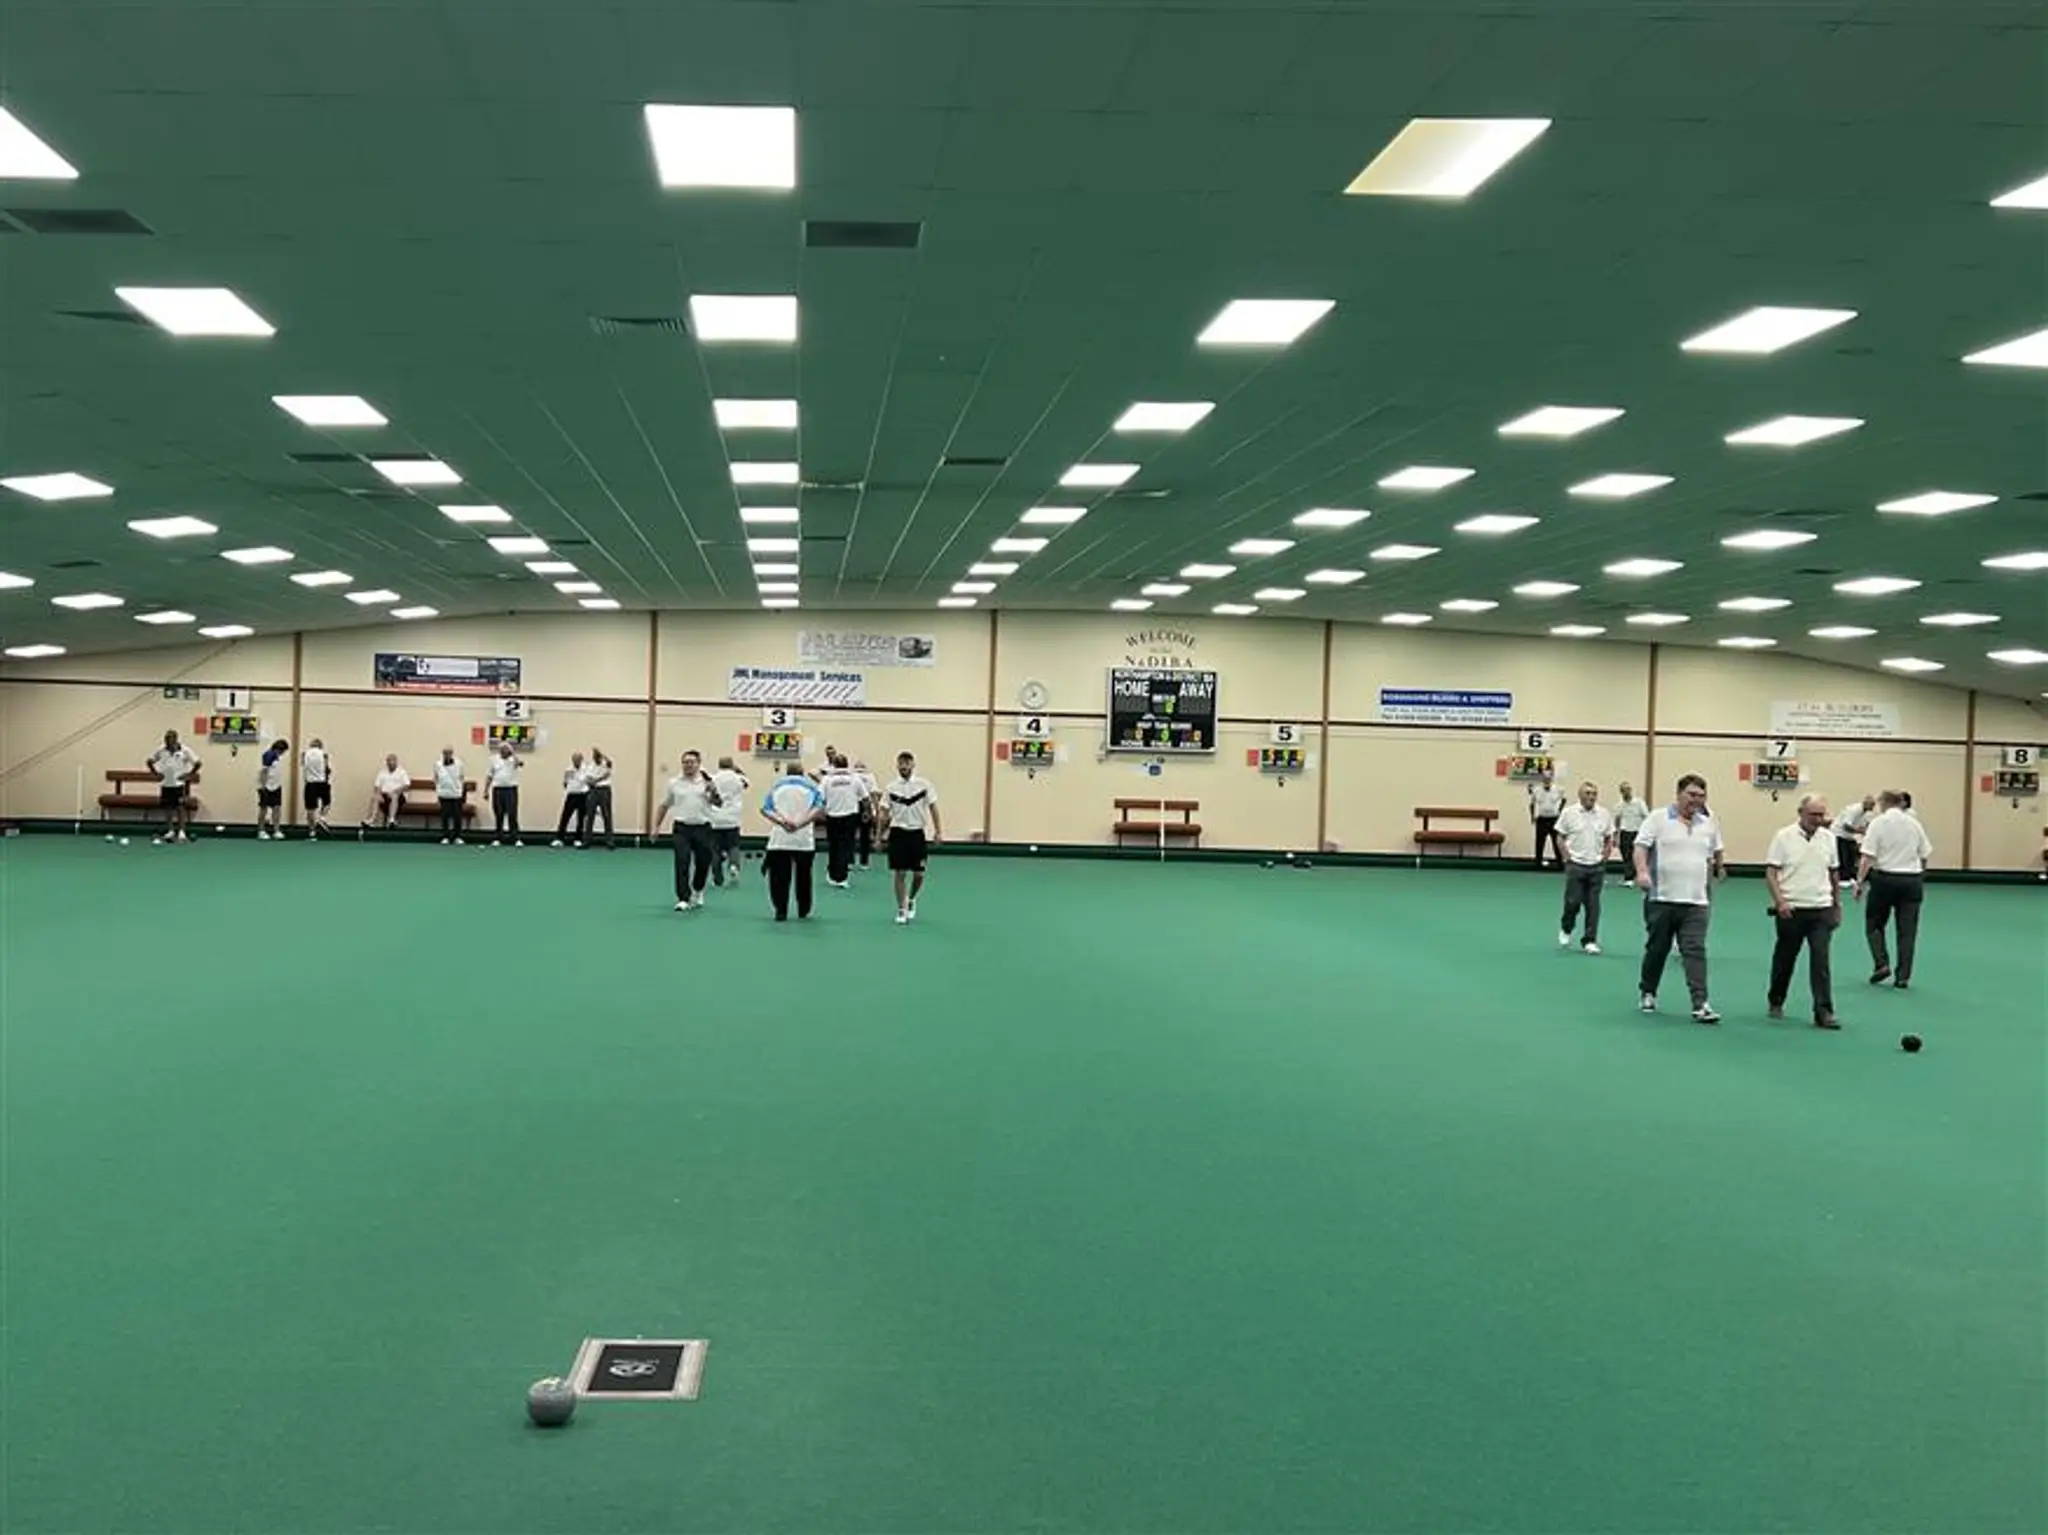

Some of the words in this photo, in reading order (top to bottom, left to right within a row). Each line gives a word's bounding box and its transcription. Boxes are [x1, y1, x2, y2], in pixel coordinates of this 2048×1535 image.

[1125, 630, 1196, 648] WELCOME
[751, 669, 815, 681] Management
[820, 671, 862, 682] Services
[1114, 681, 1151, 697] HOME
[1179, 682, 1214, 698] AWAY
[230, 692, 236, 707] 1
[505, 701, 521, 717] 2
[771, 709, 786, 725] 3
[1027, 718, 1041, 733] 4
[1278, 725, 1293, 741] 5
[1528, 733, 1543, 748] 6
[1775, 741, 1789, 756] 7
[2014, 749, 2028, 764] 8
